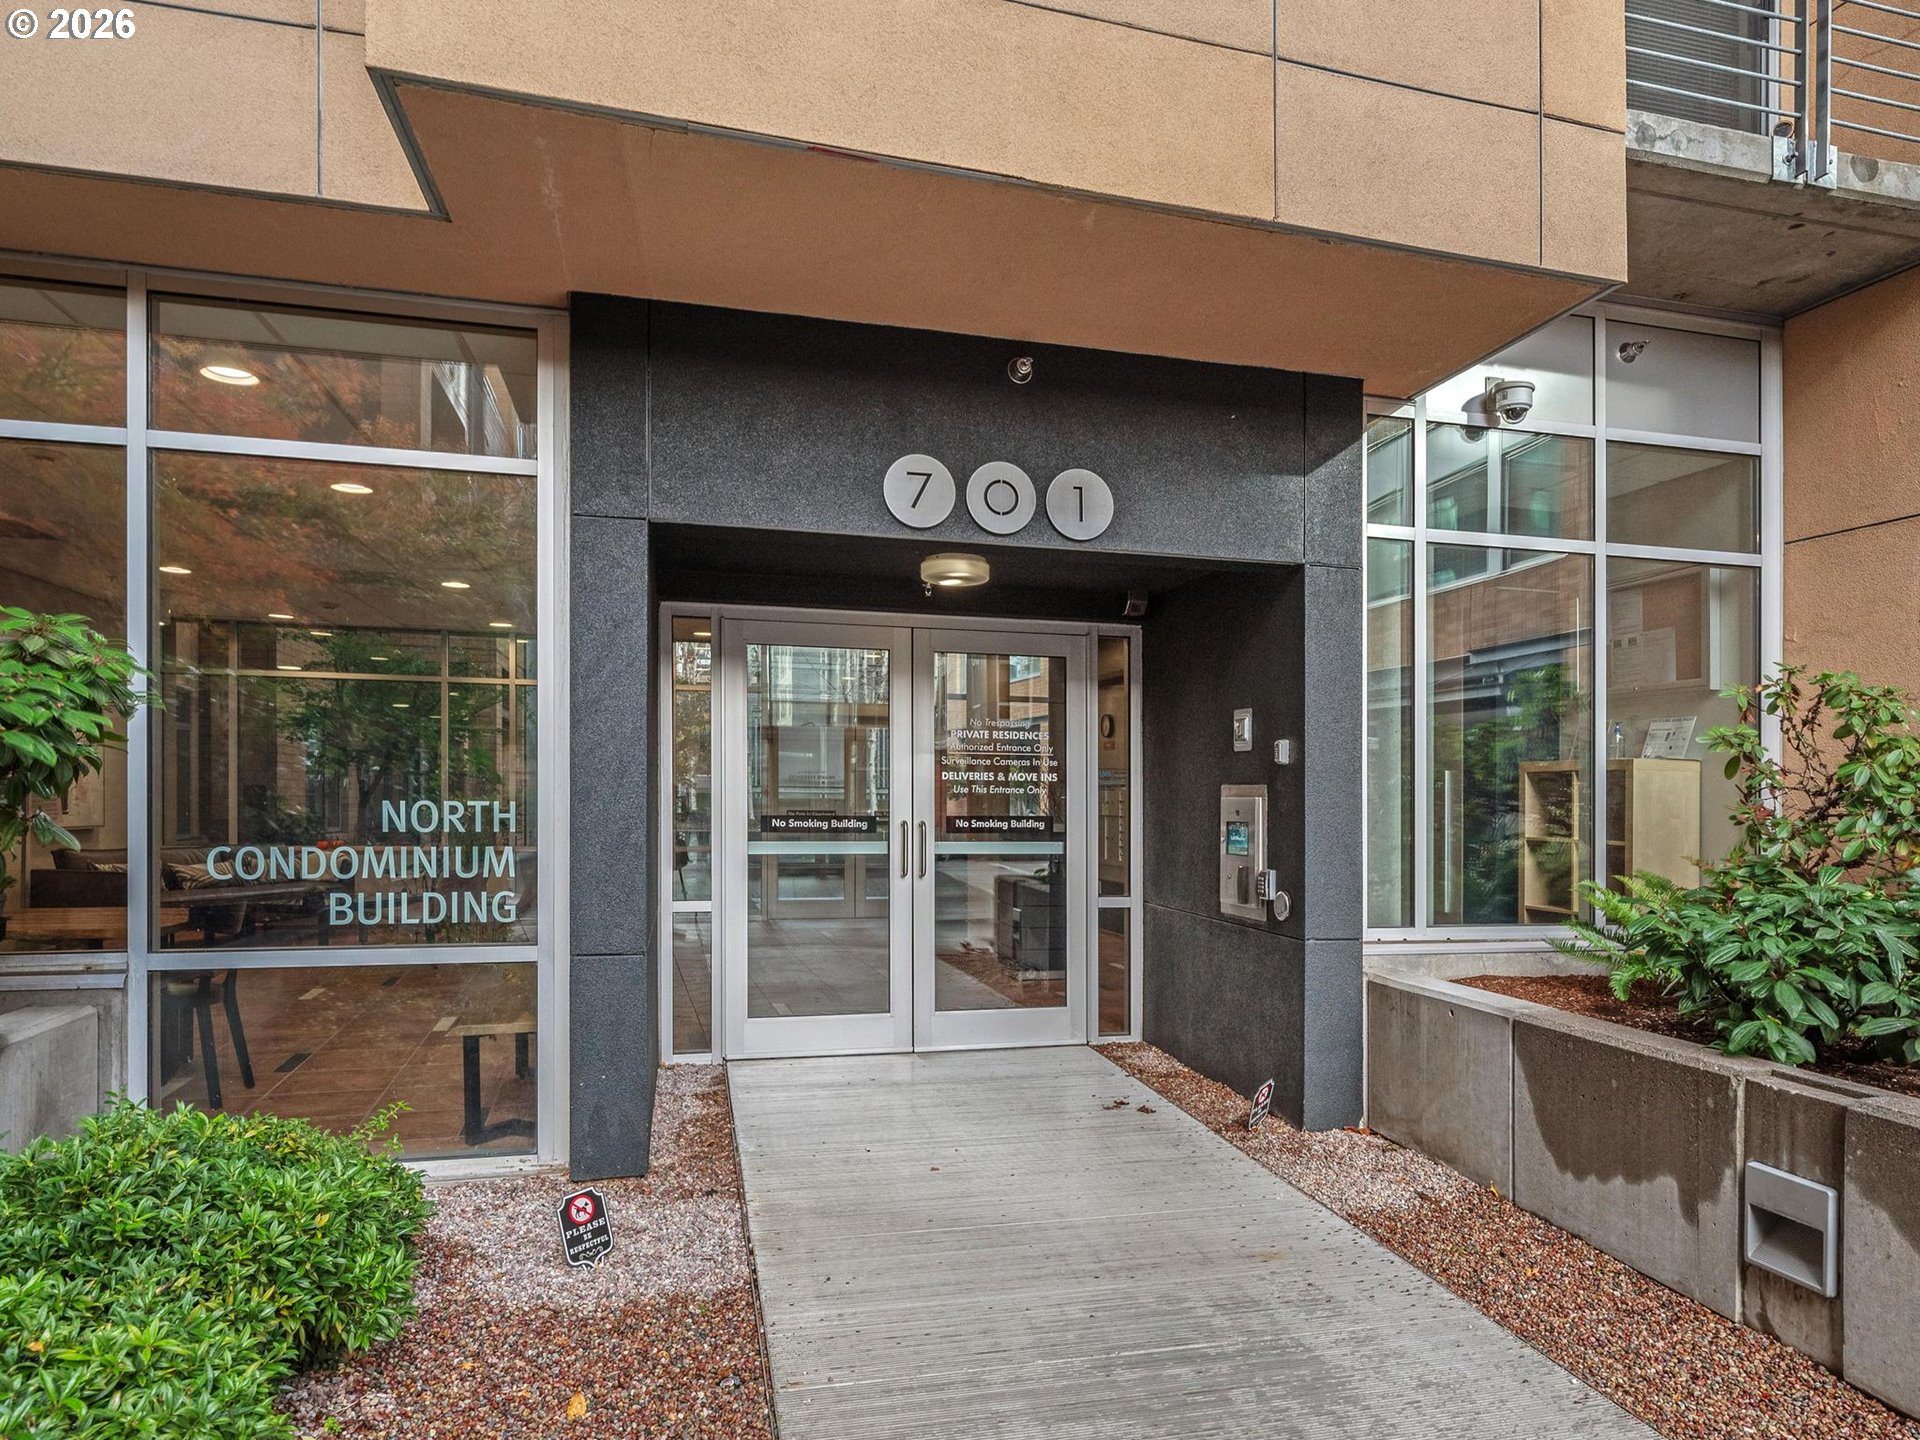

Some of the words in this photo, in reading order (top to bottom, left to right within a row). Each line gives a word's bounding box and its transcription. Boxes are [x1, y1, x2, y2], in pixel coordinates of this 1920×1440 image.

[906, 471, 1084, 523] 701
[969, 718, 983, 726] No
[985, 718, 1031, 729] Trespassing
[951, 731, 990, 739] PRIVATE
[992, 731, 1049, 740] RESIDENCES
[950, 743, 994, 752] Authorized
[997, 743, 1032, 752] Entrance
[1034, 744, 1053, 754] Only
[941, 756, 991, 766] Surveillance
[993, 758, 1031, 767] Cameras
[1032, 759, 1041, 767] In
[1043, 759, 1058, 767] Use
[941, 772, 995, 781] DELIVERIES
[998, 772, 1005, 781] &
[1008, 772, 1038, 782] MOVE
[1041, 773, 1058, 782] INS
[953, 785, 969, 794] Use
[971, 785, 988, 794] This
[989, 785, 1025, 794] Entrance
[1027, 786, 1047, 795] Only
[382, 800, 517, 833] NORTH
[771, 818, 786, 827] No
[788, 818, 829, 830] Smoking
[831, 818, 868, 830] Building
[955, 819, 969, 828] No
[971, 819, 1009, 830] Smoking
[1010, 819, 1045, 830] Building
[206, 845, 517, 880] CONDOMINIUM
[329, 890, 518, 926] BUILDING
[565, 1217, 605, 1239] PLEASE
[569, 1235, 609, 1255] RESPECTFUL
